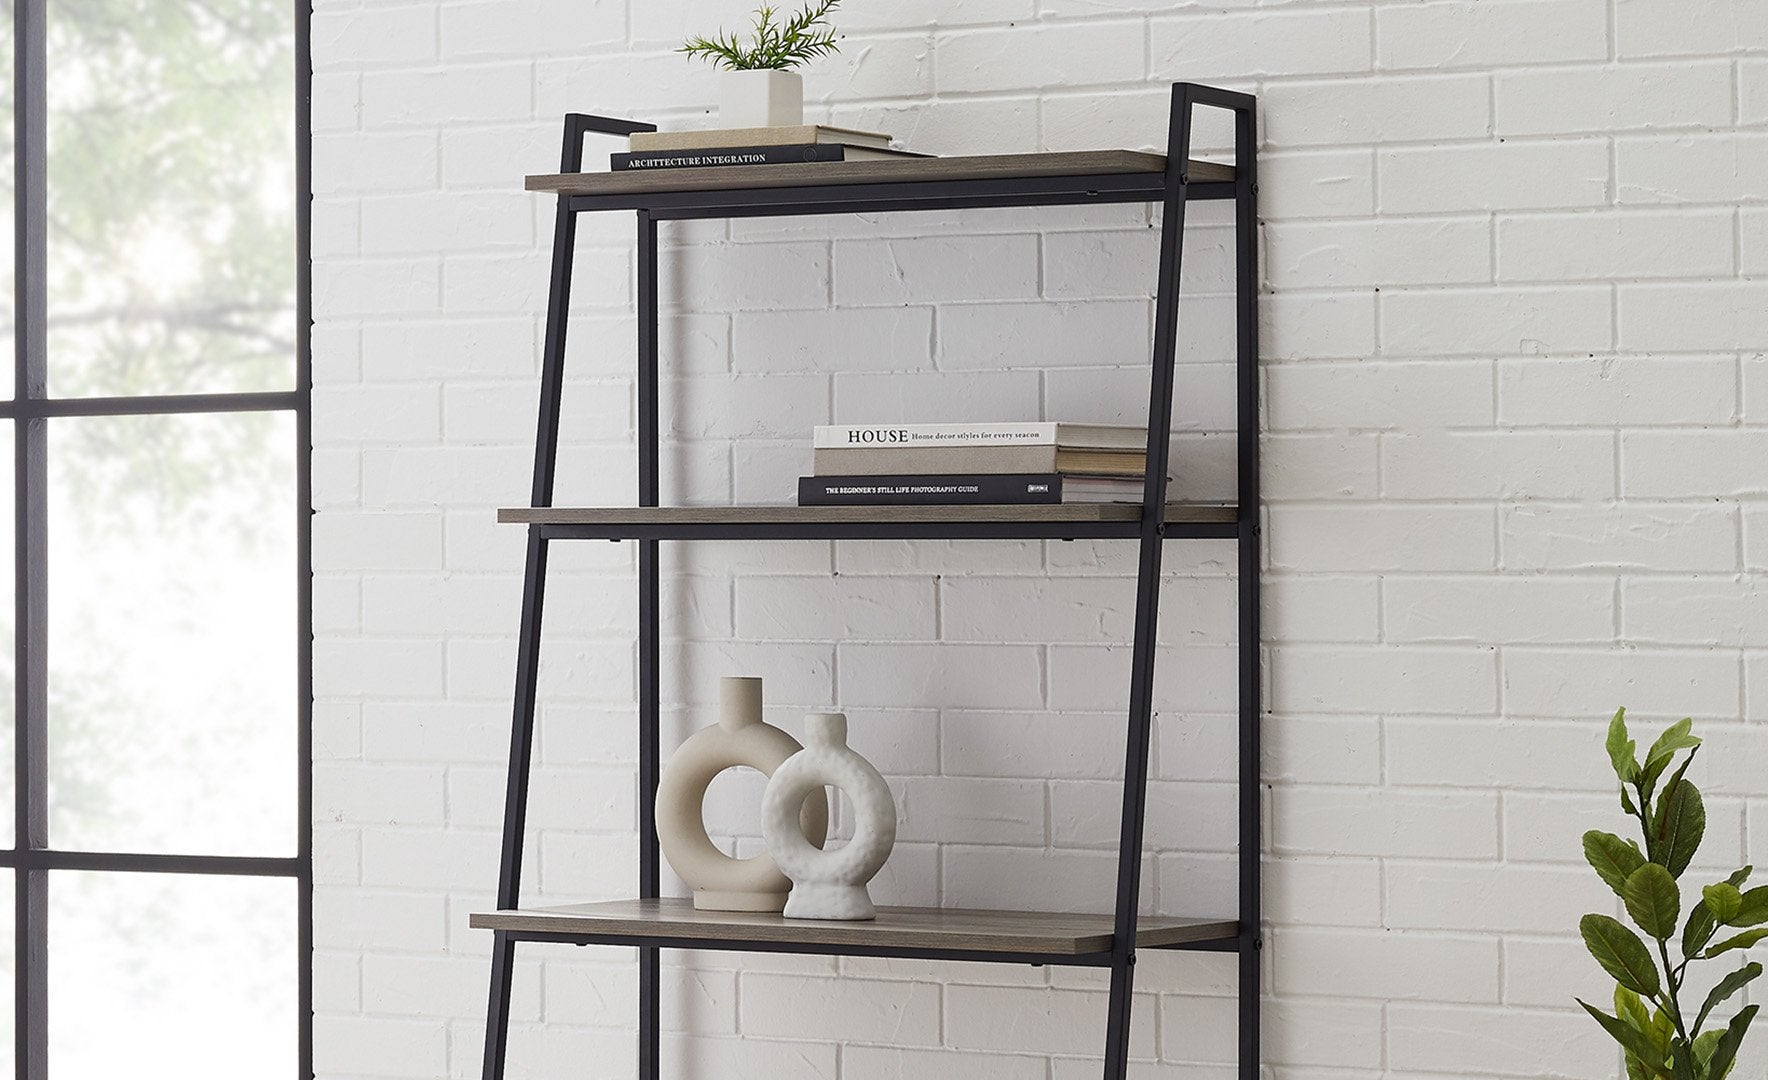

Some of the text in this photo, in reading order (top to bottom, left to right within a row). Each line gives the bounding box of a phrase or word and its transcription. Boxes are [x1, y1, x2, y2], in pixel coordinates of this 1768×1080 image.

[702, 154, 766, 164] INTEGRATION
[848, 430, 909, 443] HOUSE
[981, 431, 992, 439] for
